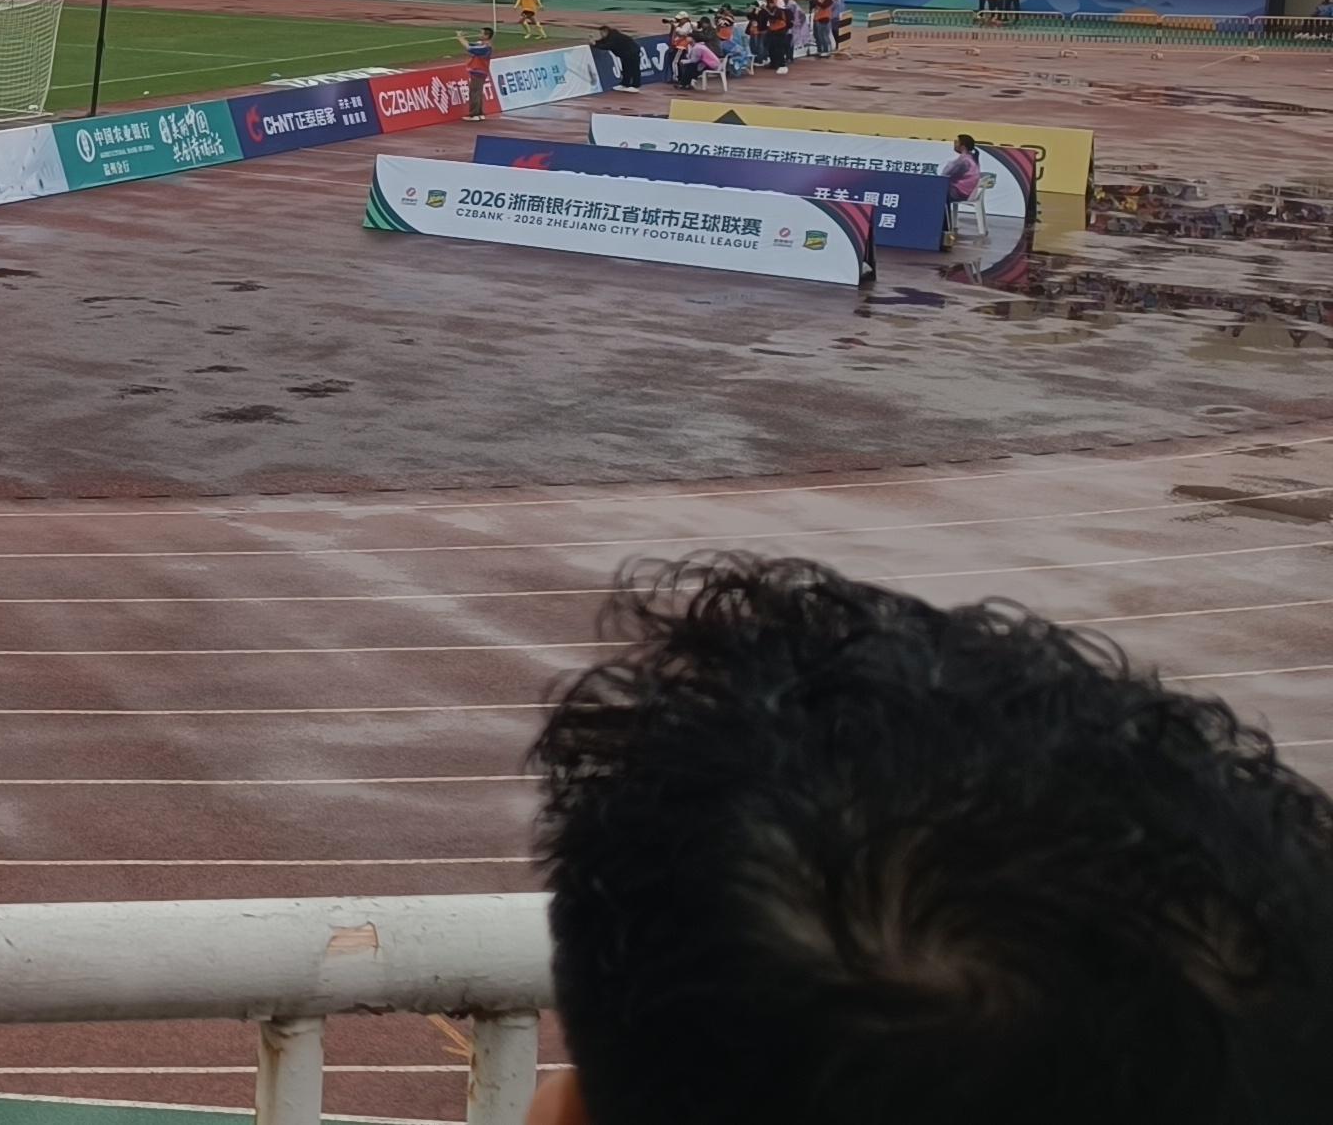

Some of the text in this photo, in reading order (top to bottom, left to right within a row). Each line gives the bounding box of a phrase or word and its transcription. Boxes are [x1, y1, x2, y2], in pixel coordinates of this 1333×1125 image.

[378, 76, 494, 117] CZBANK 浙商行
[93, 122, 151, 147] 中国农业银行
[456, 208, 503, 222] CZBANK
[518, 213, 543, 226] 2026
[547, 217, 607, 234] ZHEJIANG
[611, 223, 639, 236] CITY
[643, 227, 707, 245] FOOTBALL
[710, 235, 760, 251] LEAGUE
[457, 188, 763, 237] 2026浙商银行浙江省城市足球联赛
